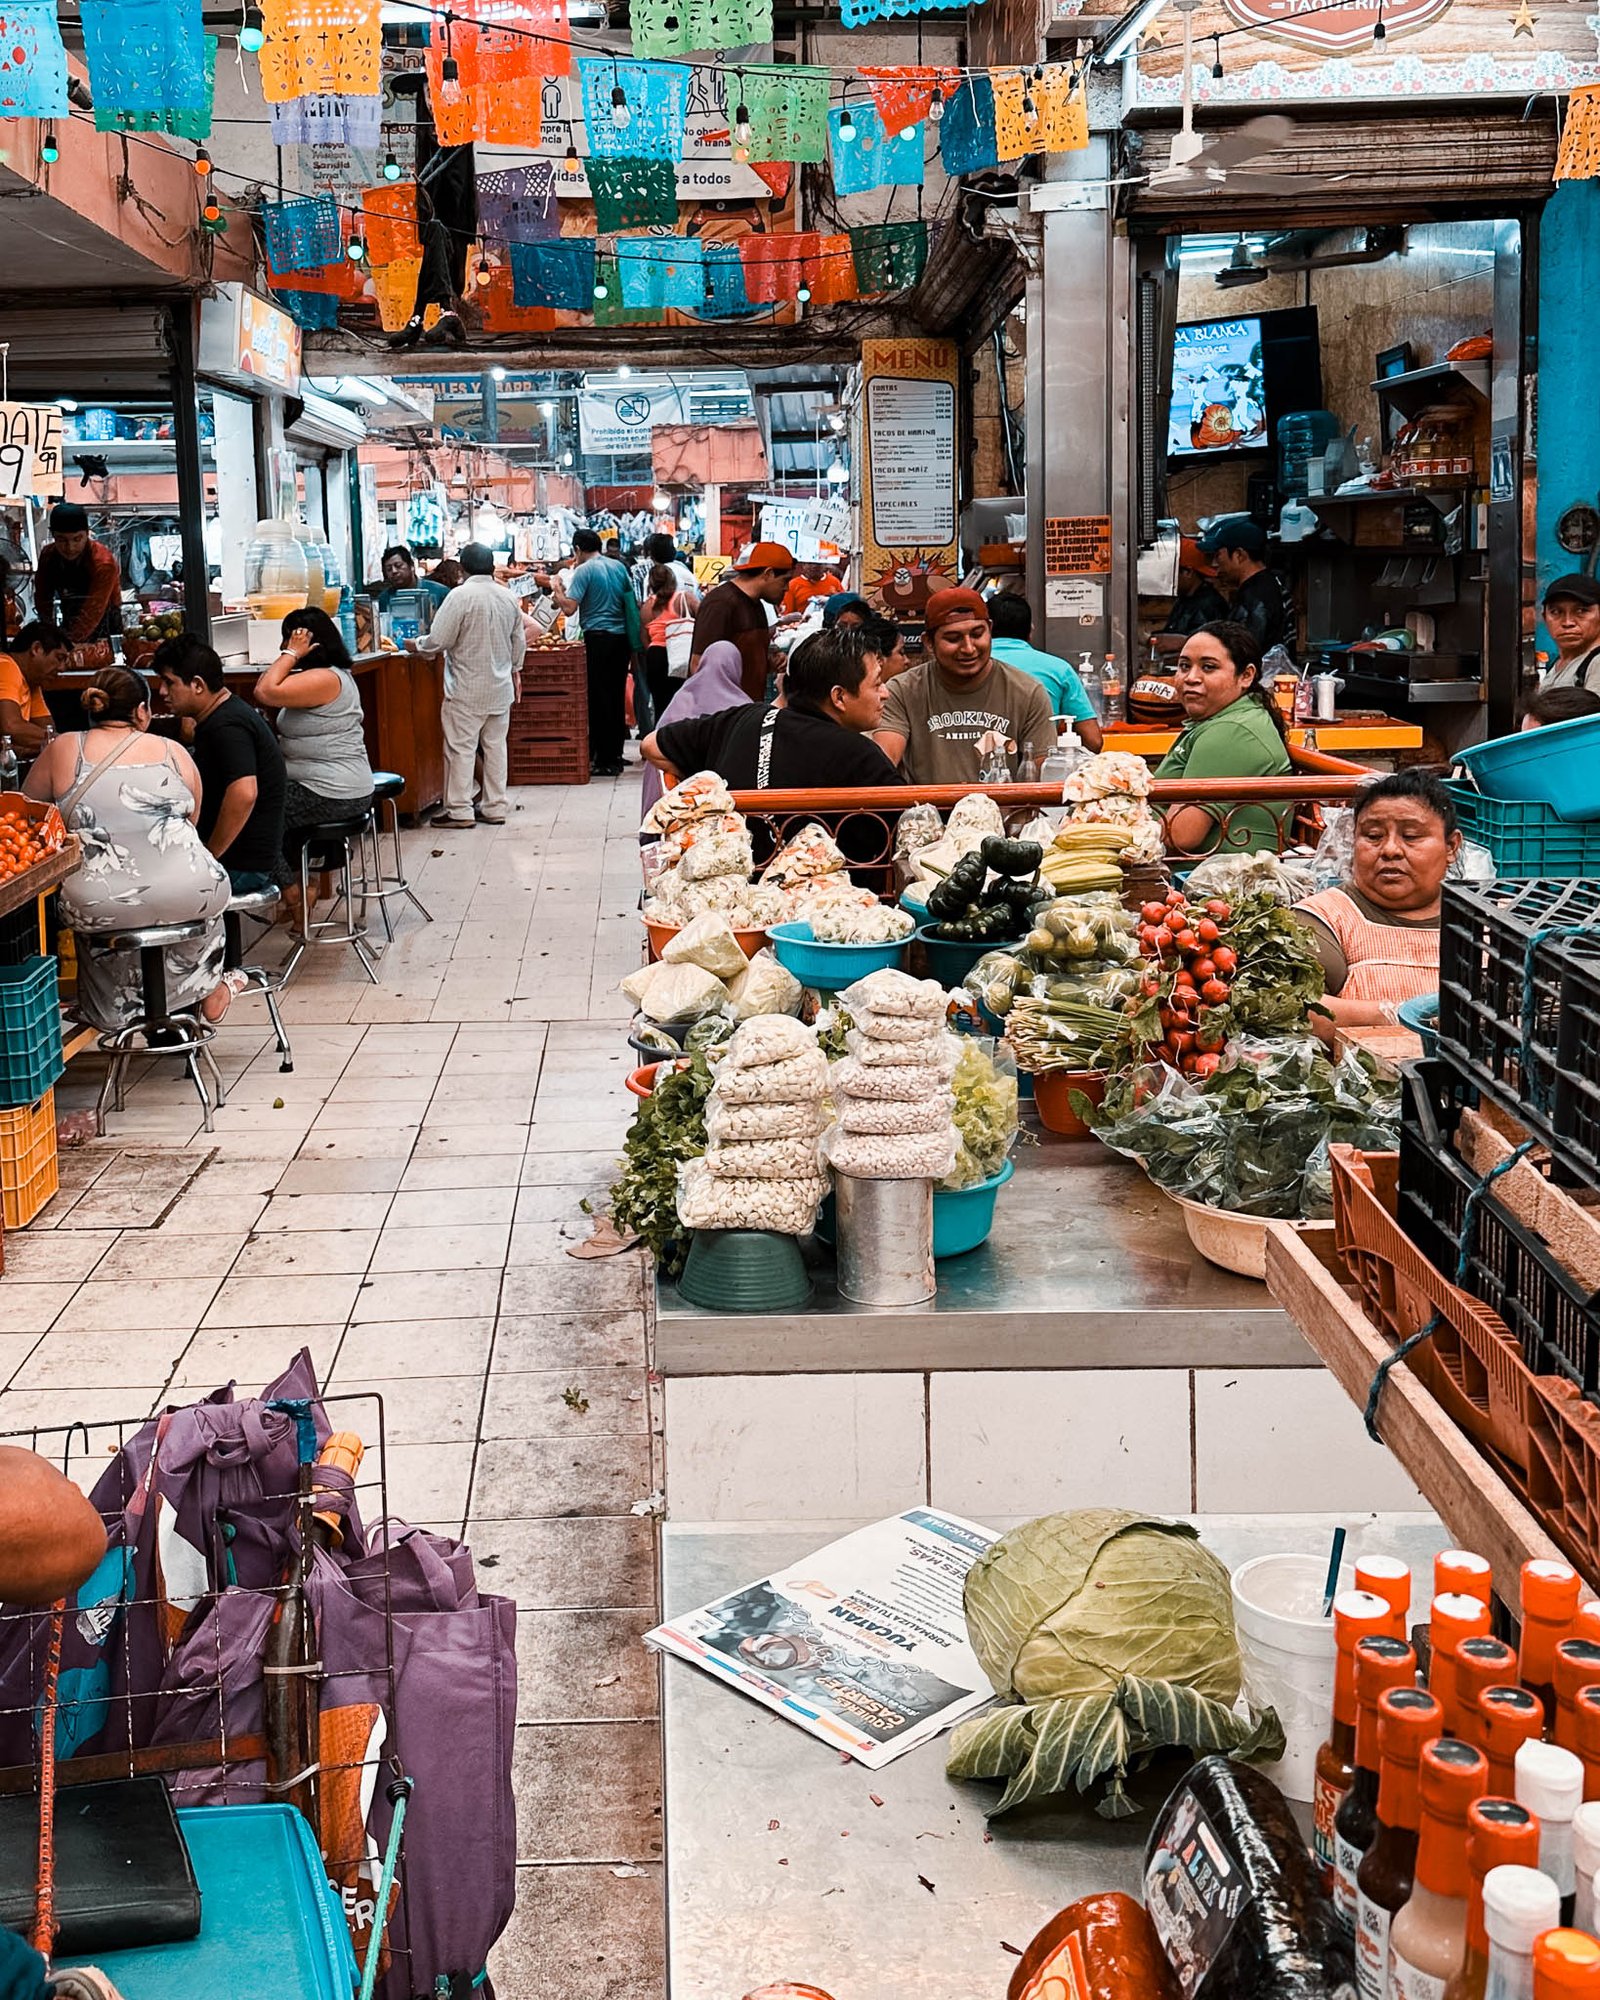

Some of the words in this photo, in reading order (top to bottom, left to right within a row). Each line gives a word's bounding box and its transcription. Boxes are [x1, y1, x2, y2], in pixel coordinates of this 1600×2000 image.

[683, 175, 690, 184] a
[693, 173, 731, 184] todos
[1194, 323, 1248, 340] BLANCA
[873, 348, 949, 370] MENU
[470, 382, 481, 394] Y
[39, 452, 57, 474] 99
[814, 513, 833, 535] 17
[1058, 528, 1099, 537] paciencia
[1047, 555, 1069, 563] como
[700, 561, 725, 581] 19
[945, 732, 981, 740] AMERICA
[924, 1515, 972, 1539] YUCATÁN
[828, 1605, 918, 1652] YUCATÁN
[893, 1615, 951, 1648] FORMALIZA
[815, 1674, 906, 1727] CASARTE?
[834, 1695, 896, 1731] ¿QUIERES
